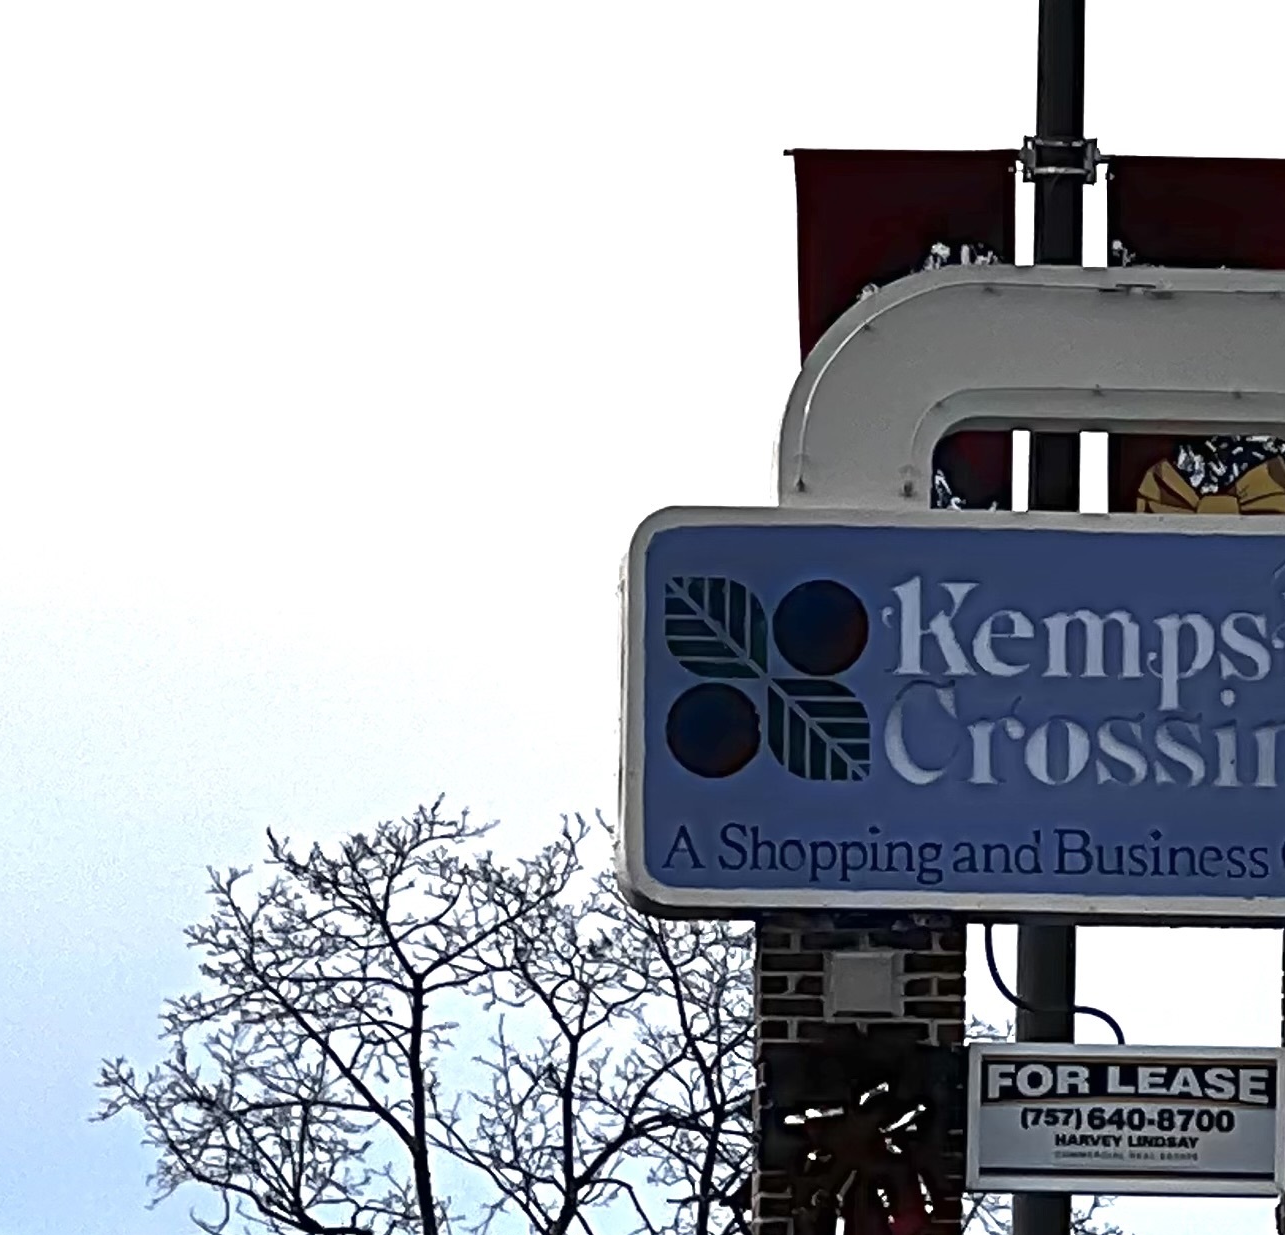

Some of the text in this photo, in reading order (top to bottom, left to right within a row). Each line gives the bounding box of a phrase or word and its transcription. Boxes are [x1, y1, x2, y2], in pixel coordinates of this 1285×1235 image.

[661, 824, 706, 870] A
[717, 822, 944, 885] Shopping
[952, 829, 1044, 875] and
[1053, 828, 1270, 879] Business
[987, 1063, 1270, 1105] FOR LEASE
[1020, 1106, 1236, 1133] (757) 640-8700
[1054, 1133, 1200, 1149] HARVEY LINDSAY
